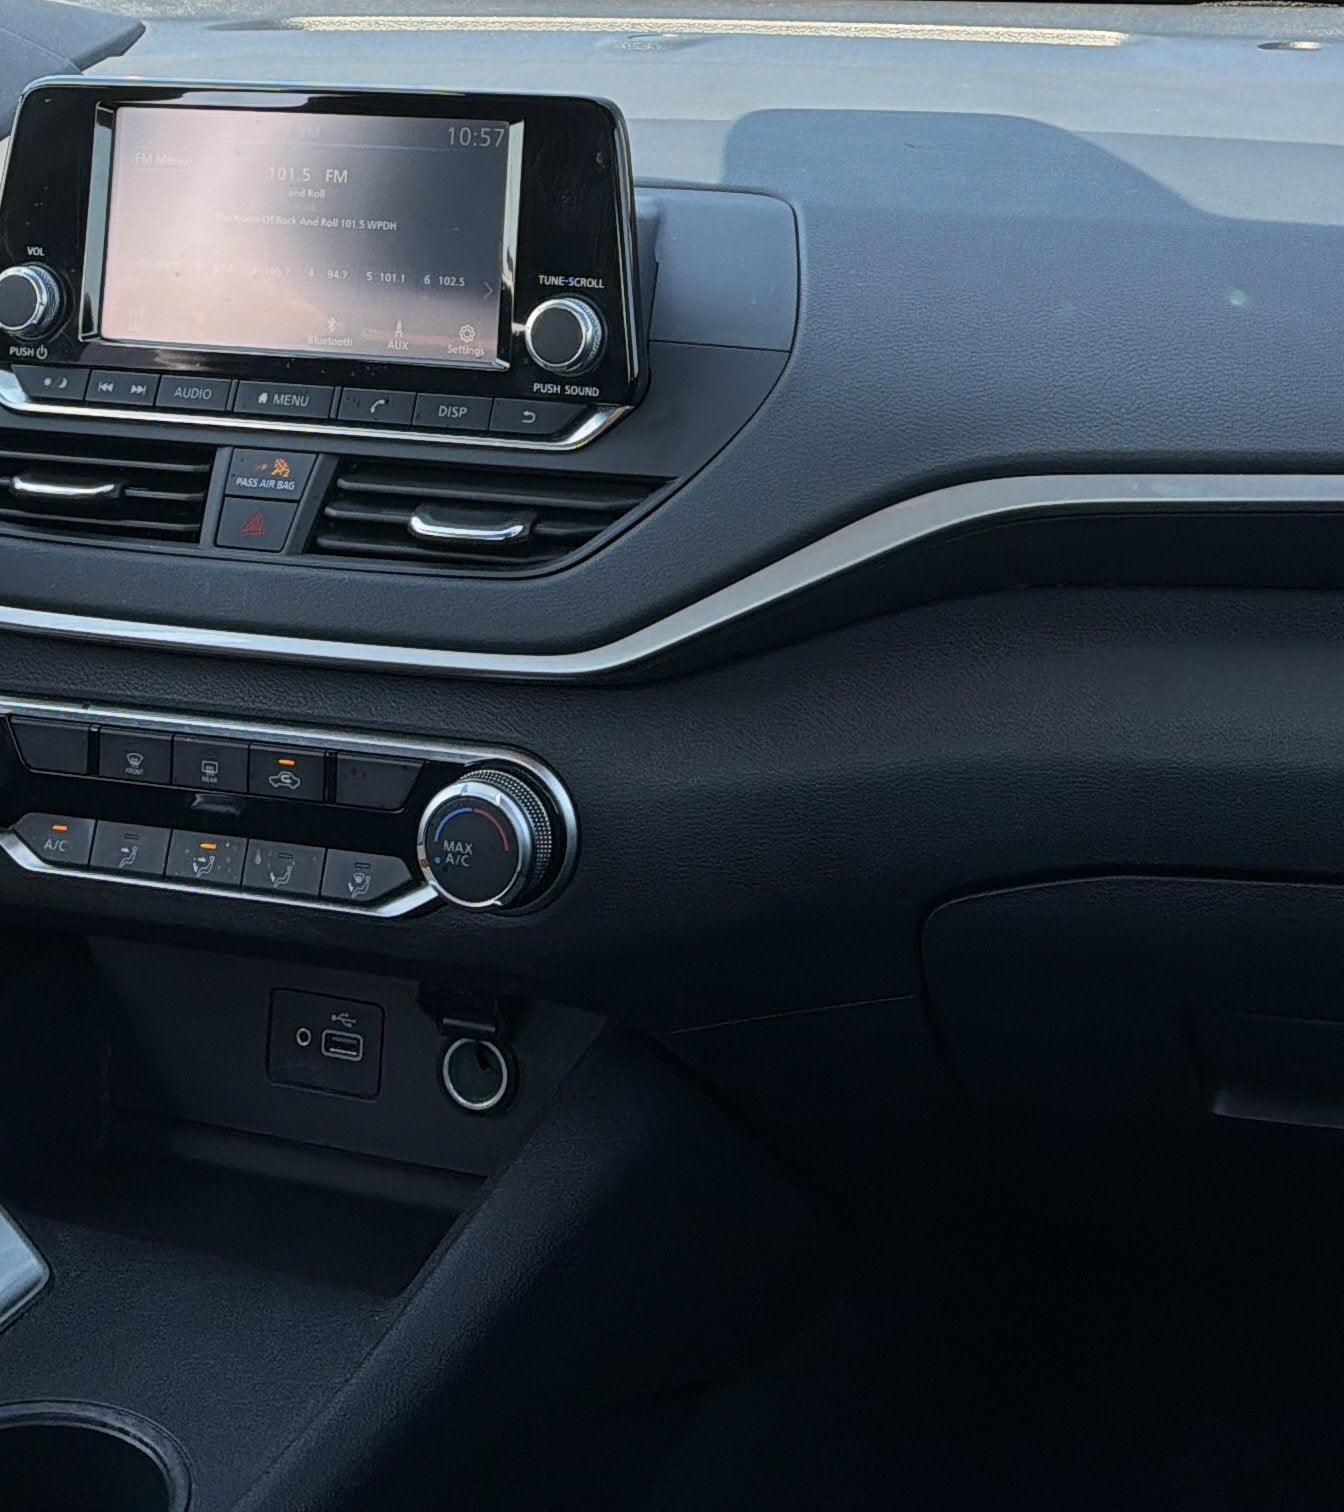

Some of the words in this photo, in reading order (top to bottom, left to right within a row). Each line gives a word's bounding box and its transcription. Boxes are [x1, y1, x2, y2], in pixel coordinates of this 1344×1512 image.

[447, 126, 505, 149] 10:57
[269, 166, 311, 183] 101.5
[325, 168, 348, 184] FM
[287, 187, 305, 199] and
[307, 188, 325, 199] Roll
[262, 214, 274, 226] Of
[276, 215, 296, 227] Rock
[300, 216, 318, 227] And
[321, 217, 338, 228] Roll
[341, 219, 364, 230] 101.5
[367, 220, 397, 231] WPDH
[27, 245, 45, 257] VOL
[327, 270, 348, 280] 94.7
[366, 271, 372, 281] 5
[380, 272, 405, 283] 101.1
[424, 274, 431, 285] 6
[439, 275, 465, 287] 102.5
[308, 335, 353, 347] Bluetooth
[387, 341, 409, 351] AUX
[9, 346, 35, 358] PUSH
[447, 343, 485, 357] Settings
[173, 386, 213, 401] AUDIO
[533, 382, 560, 395] PUSH
[564, 385, 600, 397] SOUND
[272, 394, 310, 408] MENU
[438, 405, 468, 419] DISP
[236, 476, 258, 488] PASS
[259, 479, 275, 489] AIR
[276, 480, 295, 491] BAG
[43, 838, 66, 853] A/C
[443, 839, 473, 855] MAX
[445, 852, 470, 868] A/C
